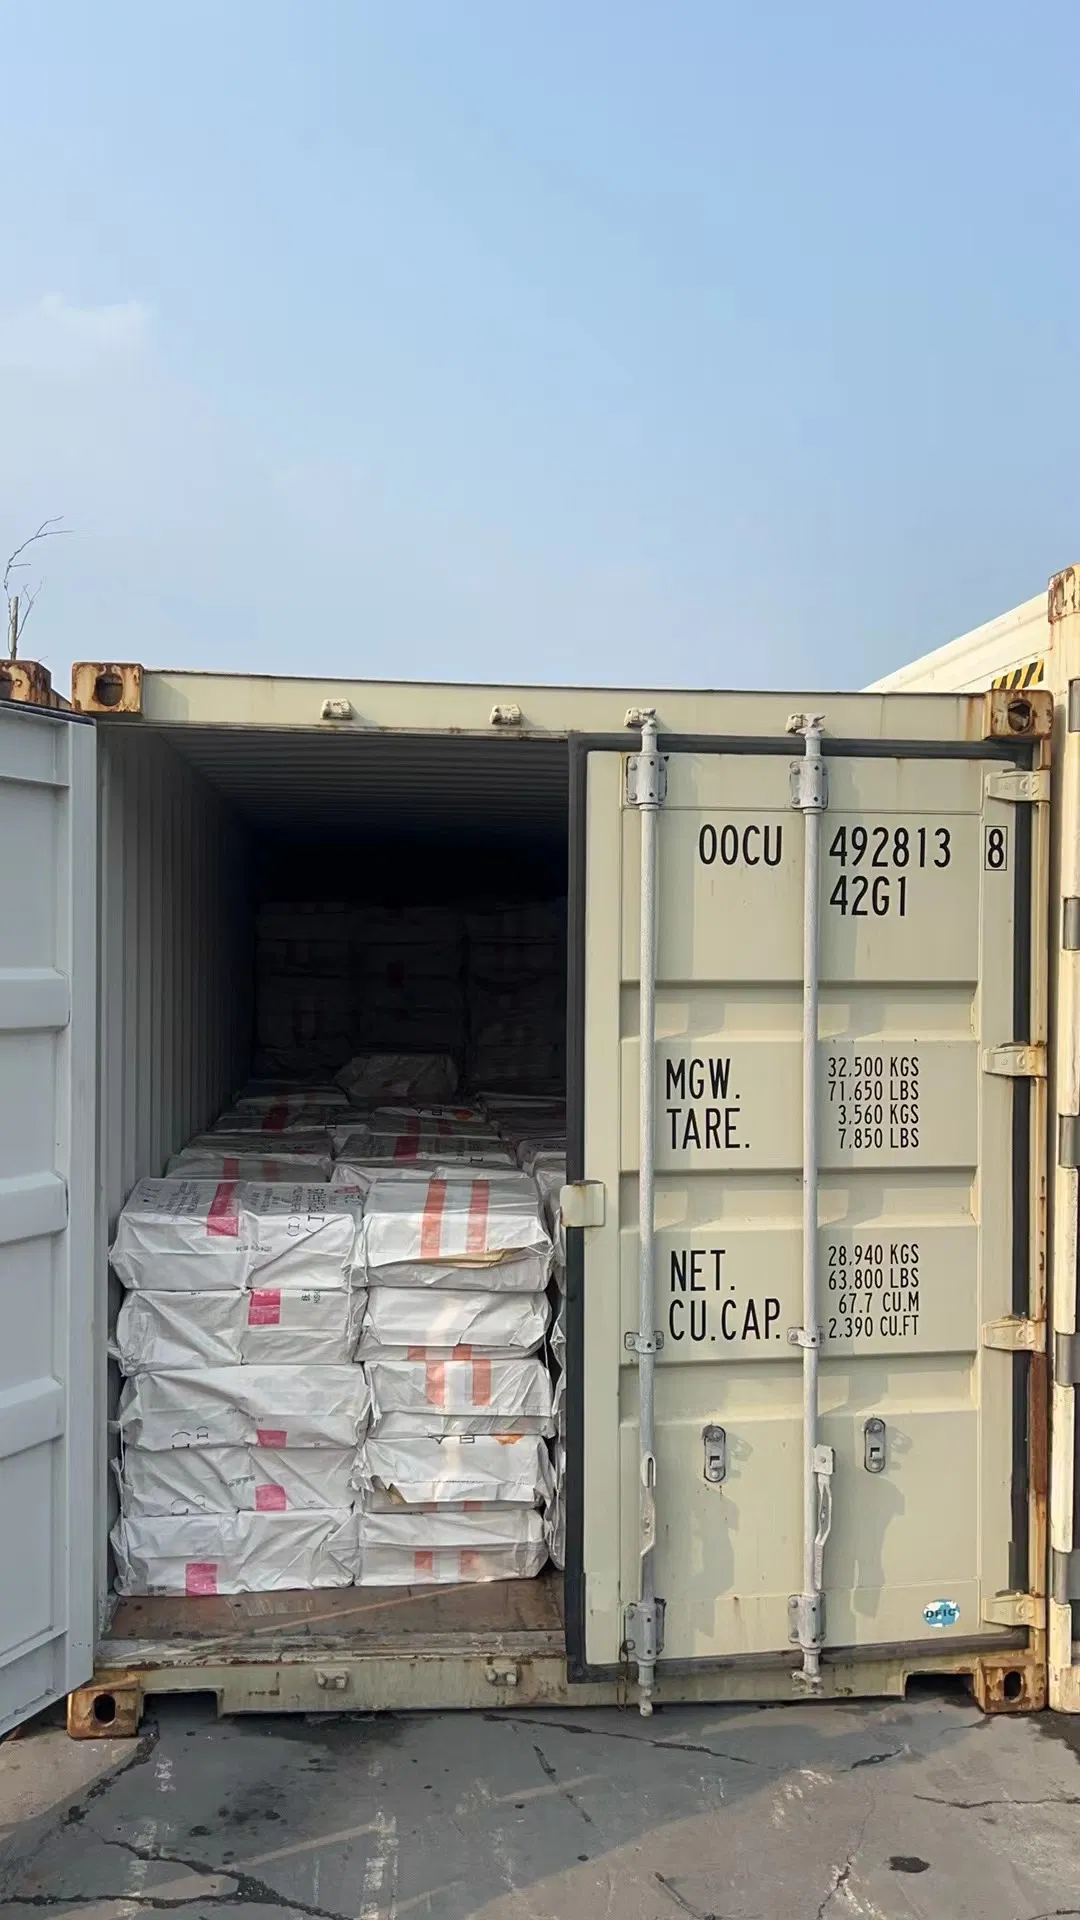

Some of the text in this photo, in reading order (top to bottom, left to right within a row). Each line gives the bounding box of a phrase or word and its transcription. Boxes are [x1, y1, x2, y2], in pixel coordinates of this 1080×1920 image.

[828, 825, 951, 868] 492813
[987, 828, 1004, 869] 8
[829, 874, 906, 917] 42G1
[890, 1056, 919, 1077] KGS
[666, 1058, 740, 1100] MGW.
[890, 1079, 919, 1101] LBS
[889, 1103, 919, 1125] KGS
[666, 1107, 750, 1150] TARE.
[890, 1127, 919, 1149] LBS
[890, 1243, 919, 1265] KGS
[670, 1249, 735, 1292] NET.
[890, 1267, 919, 1289] LBS
[838, 1290, 919, 1315] 67.7 CU.M
[668, 1298, 781, 1342] CU.CAP.
[879, 1314, 919, 1337] CU.FT
